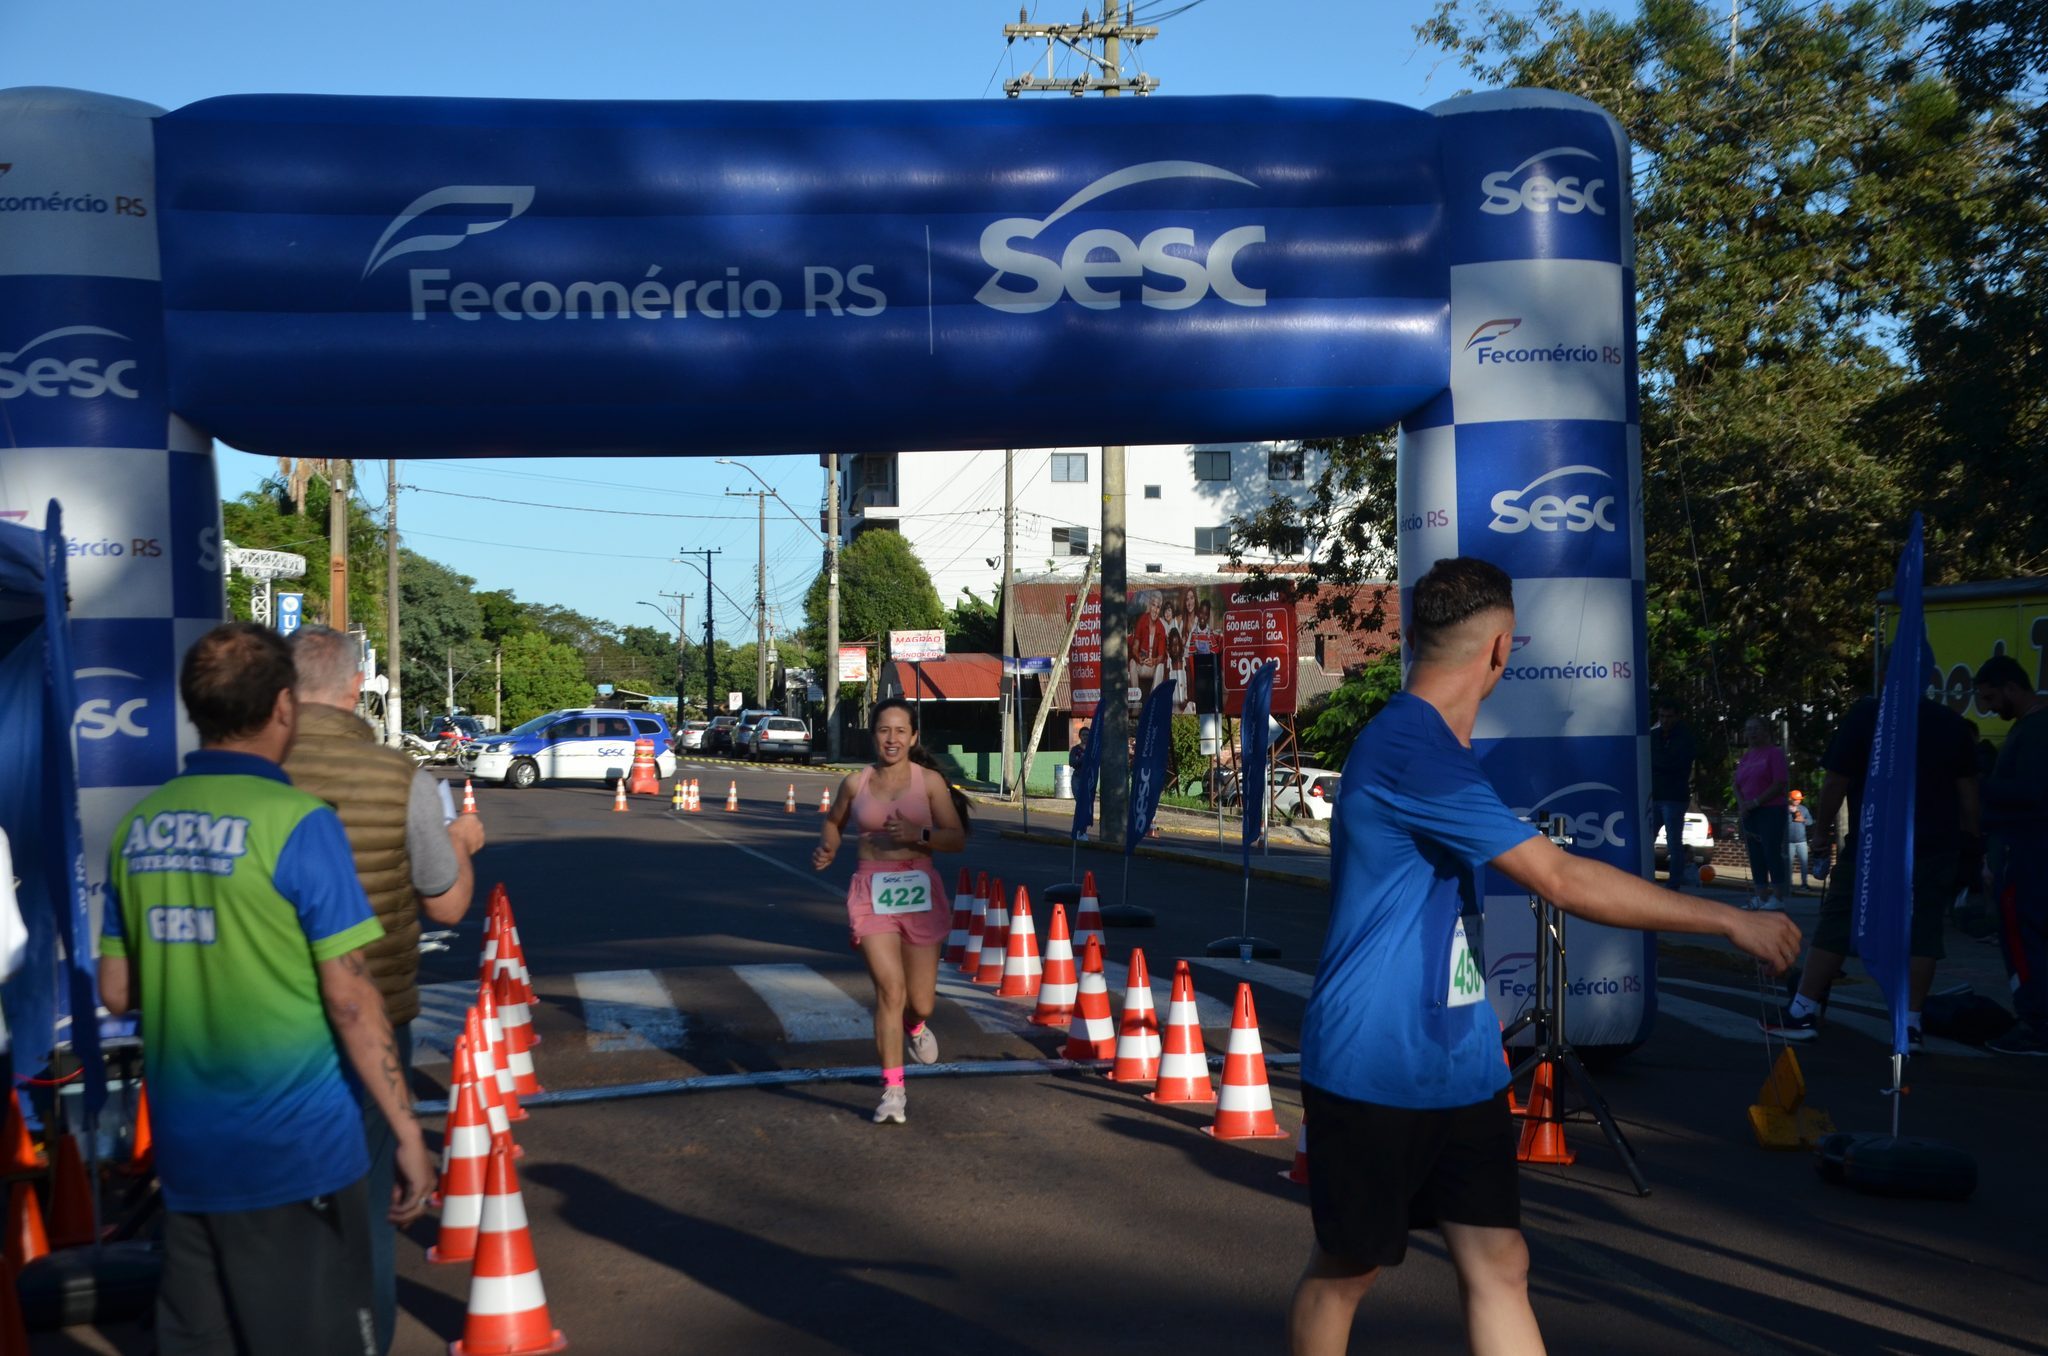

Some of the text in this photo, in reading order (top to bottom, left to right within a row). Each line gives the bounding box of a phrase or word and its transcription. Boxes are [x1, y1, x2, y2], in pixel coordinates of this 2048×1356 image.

[115, 196, 147, 218] RS
[409, 264, 887, 320] Fecomércio RS
[1478, 344, 1621, 365] Fecomércio RS
[1427, 509, 1449, 528] RS
[132, 538, 162, 557] RS
[1226, 620, 1260, 631] 600 MEGA
[1266, 619, 1276, 629] 60
[1266, 630, 1283, 640] GIGA
[1612, 662, 1631, 678] RS
[122, 812, 249, 857] ACEMI
[878, 885, 925, 907] 422
[1623, 976, 1640, 993] RS
